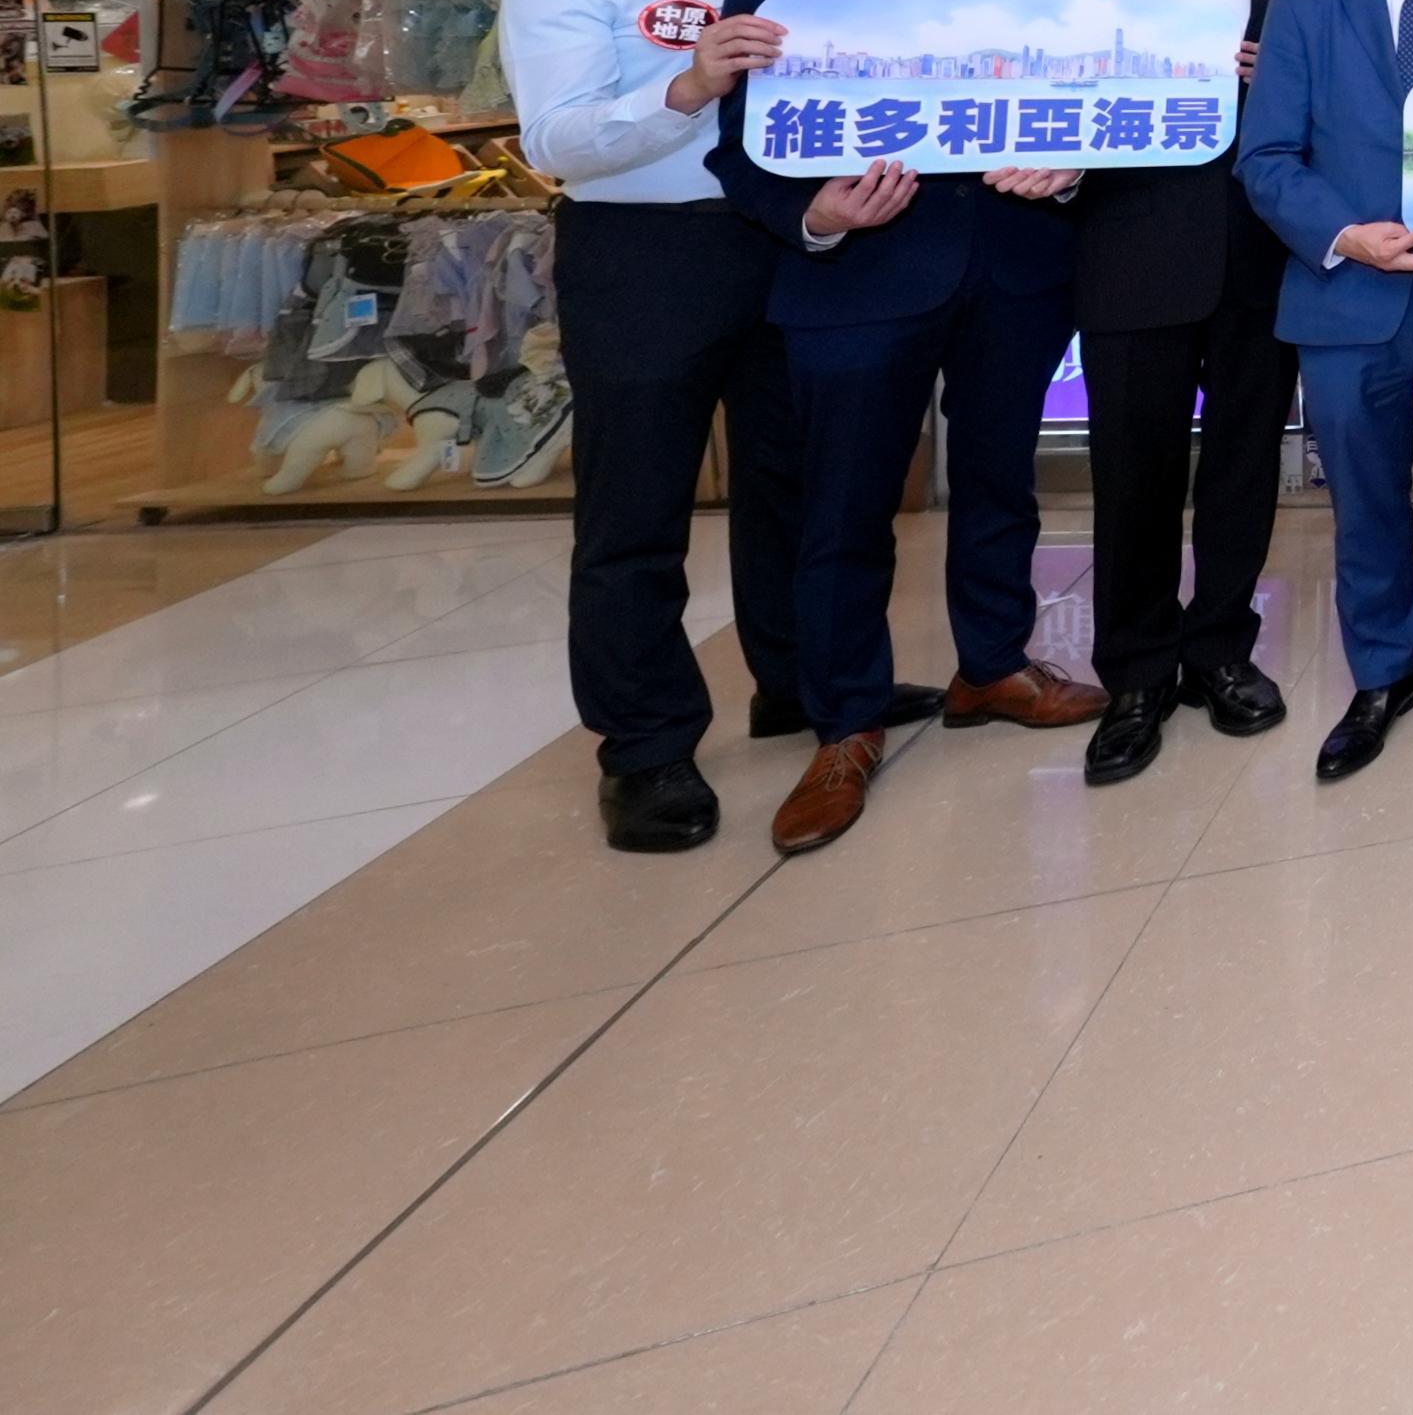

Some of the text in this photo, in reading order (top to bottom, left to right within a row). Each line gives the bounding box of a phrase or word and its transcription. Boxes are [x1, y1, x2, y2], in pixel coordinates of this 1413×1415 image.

[655, 5, 708, 25] 中原
[651, 21, 704, 42] 地產
[762, 97, 1223, 160] 維多利亞海景
